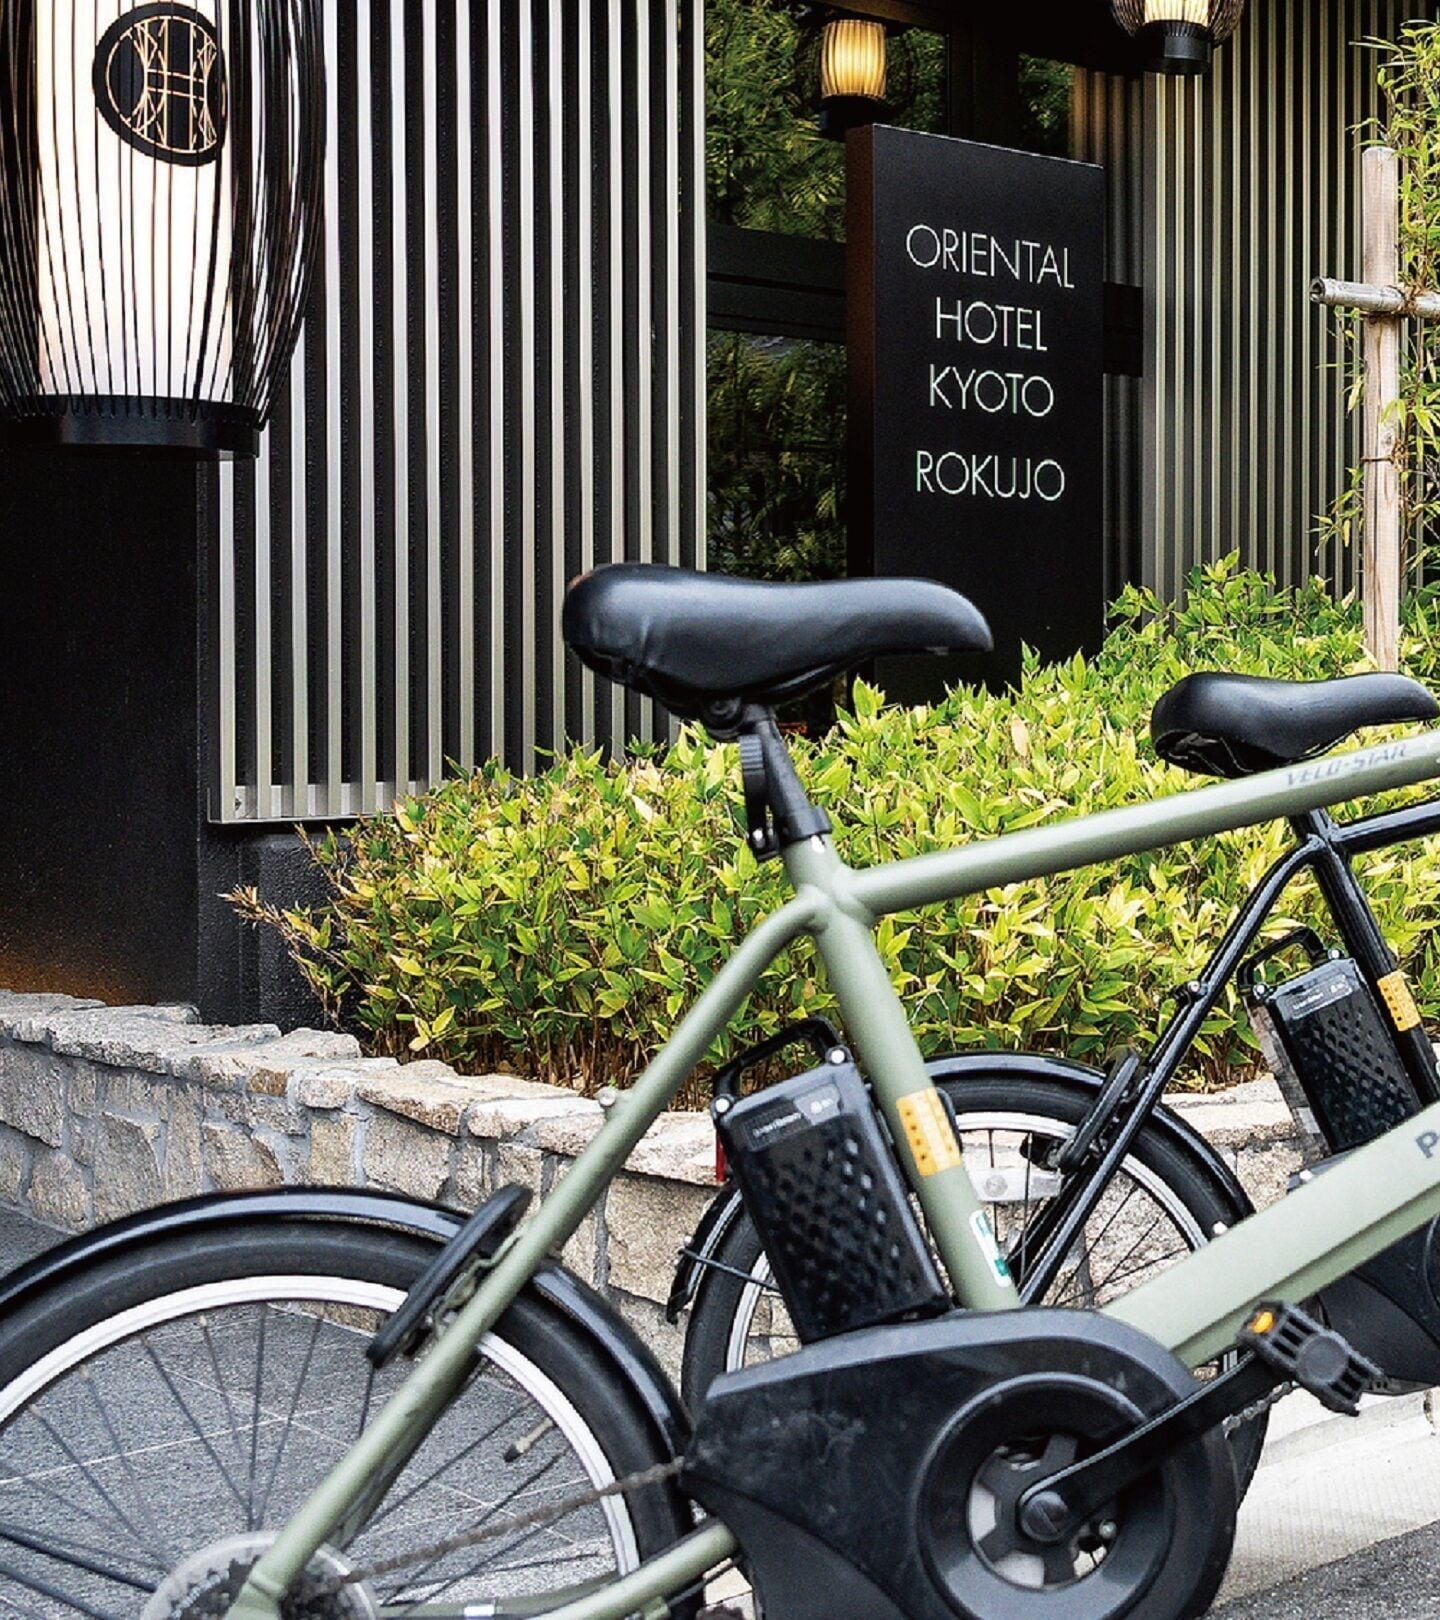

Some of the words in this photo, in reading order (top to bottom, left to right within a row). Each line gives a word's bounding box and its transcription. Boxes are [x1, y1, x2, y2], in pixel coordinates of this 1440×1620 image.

[906, 224, 1075, 289] ORIENTAL
[935, 296, 1048, 351] HOTEL
[929, 363, 1054, 417] KYOTO
[916, 450, 1065, 501] ROKUJO
